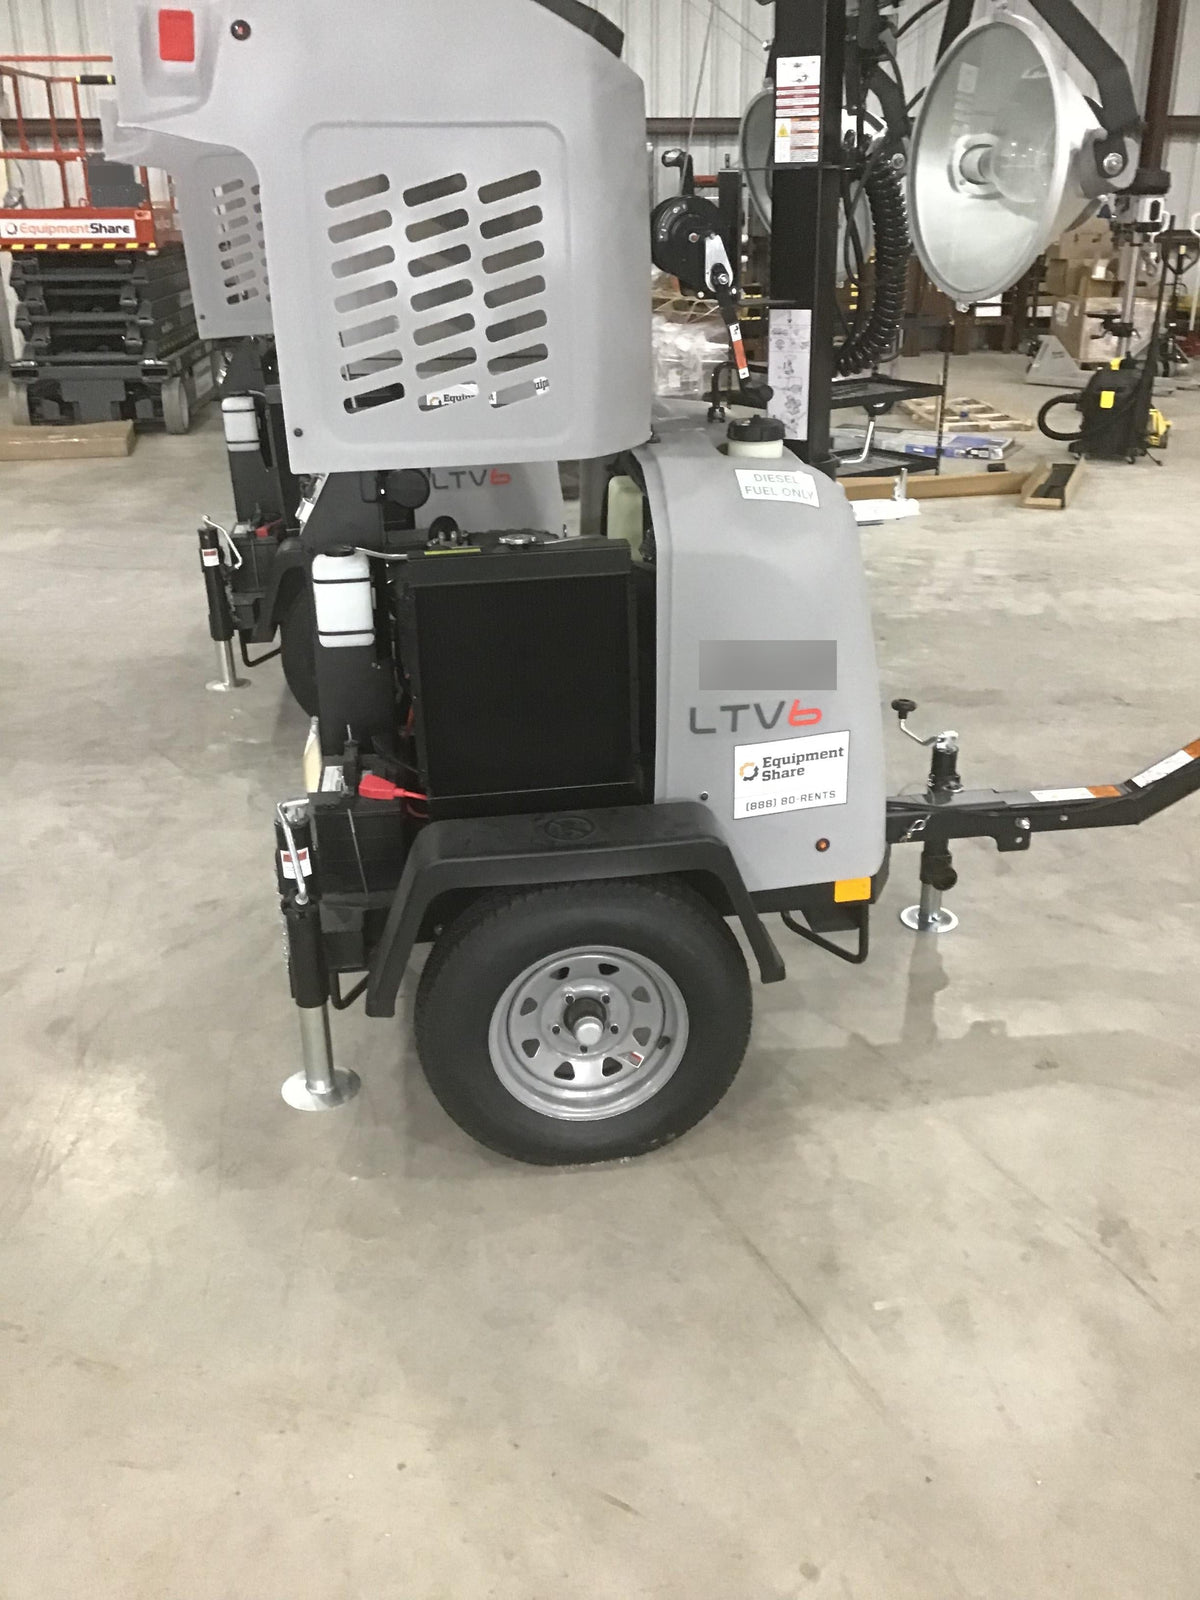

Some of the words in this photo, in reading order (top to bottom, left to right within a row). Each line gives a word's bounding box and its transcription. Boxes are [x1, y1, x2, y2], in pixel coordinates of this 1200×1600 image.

[19, 222, 130, 235] EquipmentShare
[431, 467, 512, 489] LTV6
[753, 473, 800, 484] DIESEL
[744, 485, 778, 496] FUEL
[782, 487, 814, 500] ONLY
[689, 699, 823, 735] LTV6
[761, 747, 844, 769] Equipment
[761, 766, 805, 782] Share
[745, 798, 777, 812] (888)
[780, 790, 836, 806] 80-RENTS
